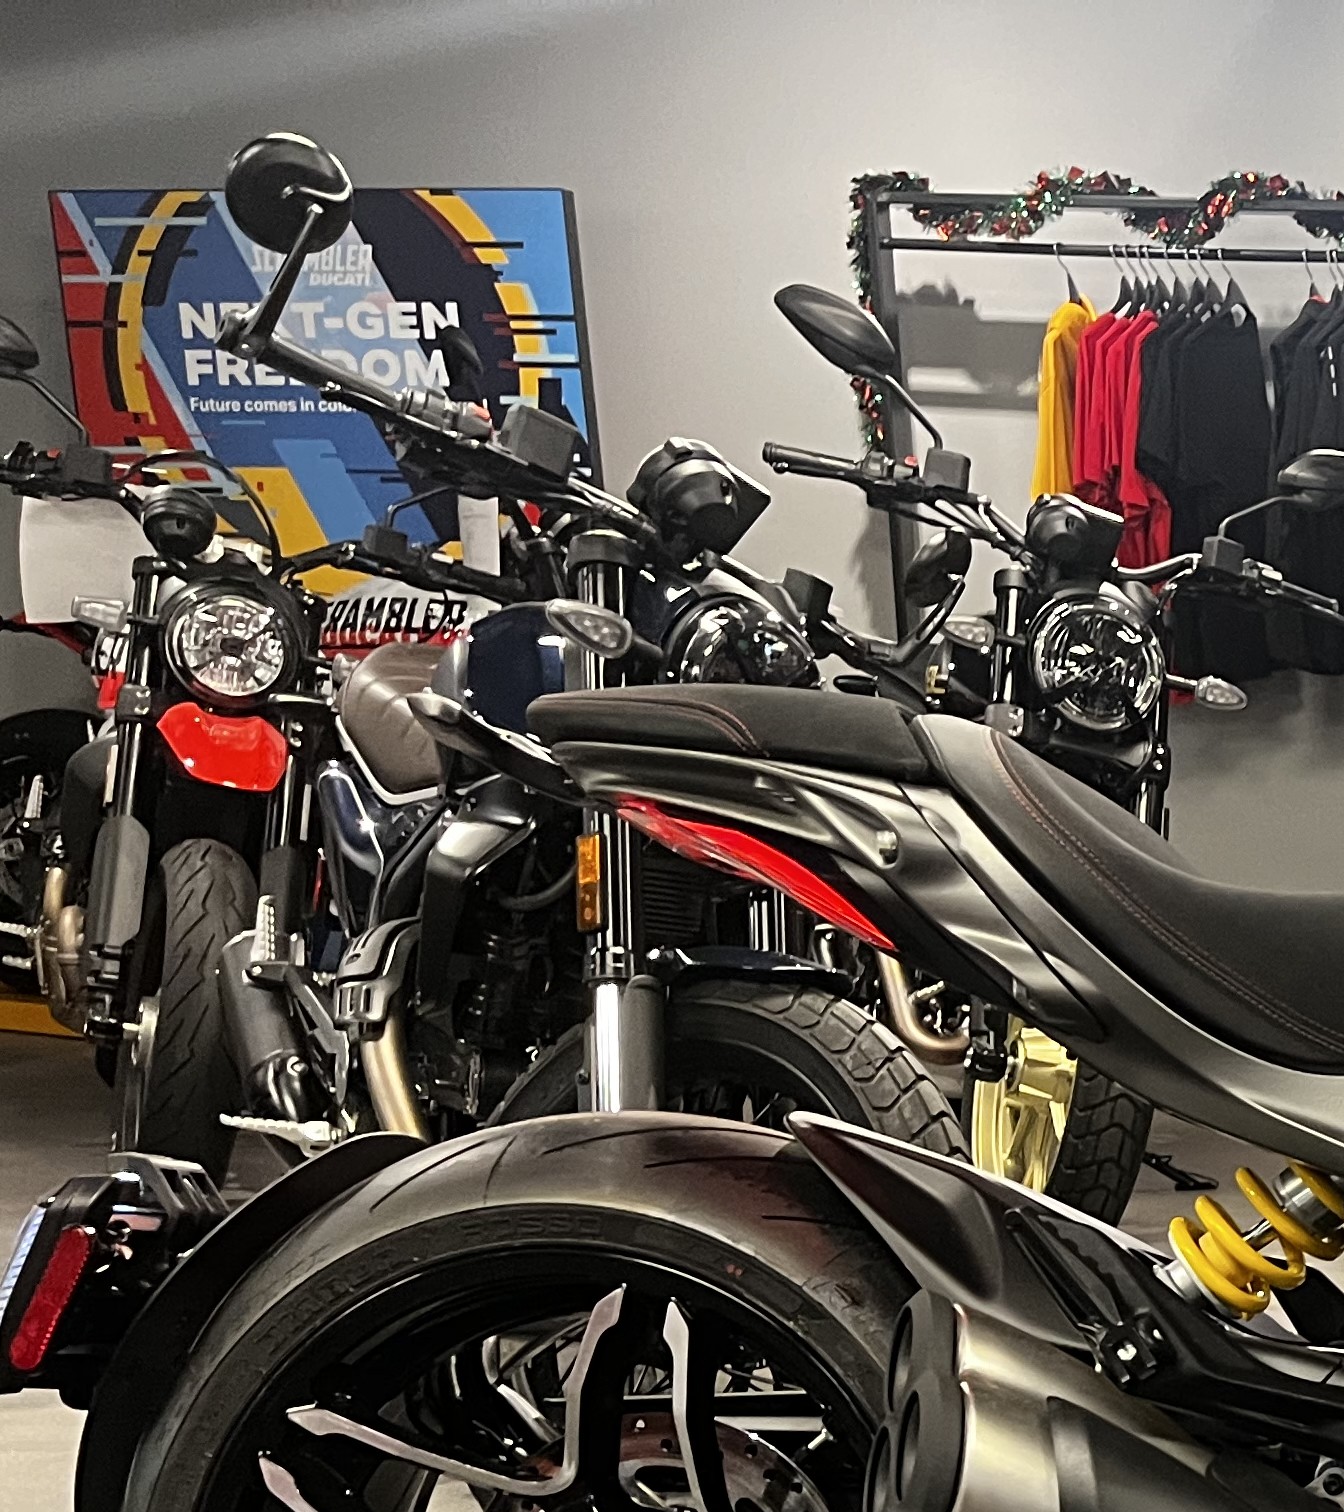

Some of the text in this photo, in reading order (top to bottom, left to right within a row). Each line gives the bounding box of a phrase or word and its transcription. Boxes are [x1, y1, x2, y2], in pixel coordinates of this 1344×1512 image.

[252, 245, 373, 273] SCMBLER
[309, 272, 371, 287] DUCATI
[179, 301, 460, 340] NT-GEN
[184, 349, 449, 386] FREOM
[190, 397, 240, 412] Future
[244, 399, 296, 412] comes
[323, 597, 468, 633] RAMBLER
